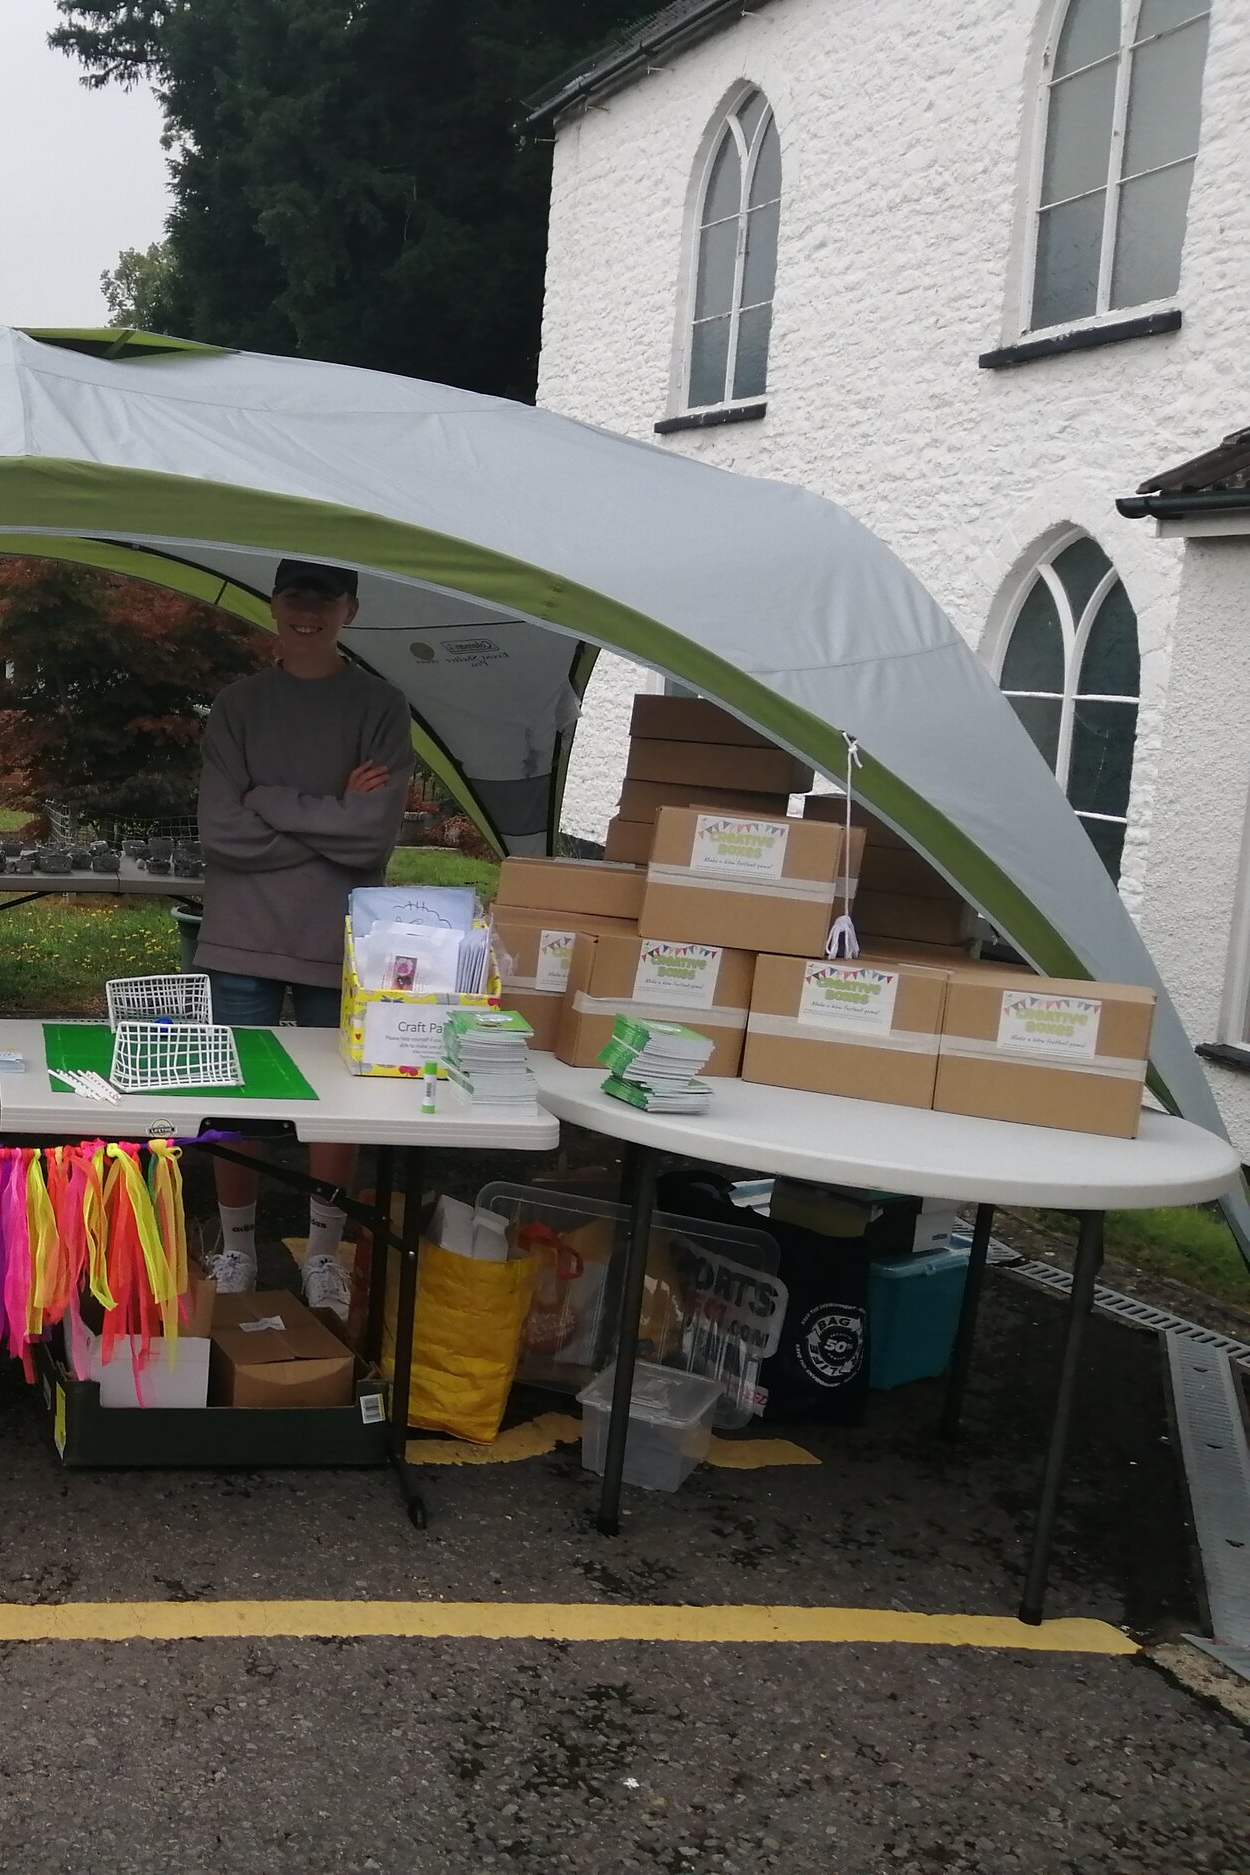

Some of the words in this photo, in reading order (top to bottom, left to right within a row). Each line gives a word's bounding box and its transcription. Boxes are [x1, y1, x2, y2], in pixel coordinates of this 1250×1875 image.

[398, 1021, 426, 1033] Craft
[429, 1022, 444, 1034] Pa
[817, 1316, 851, 1332] BAG
